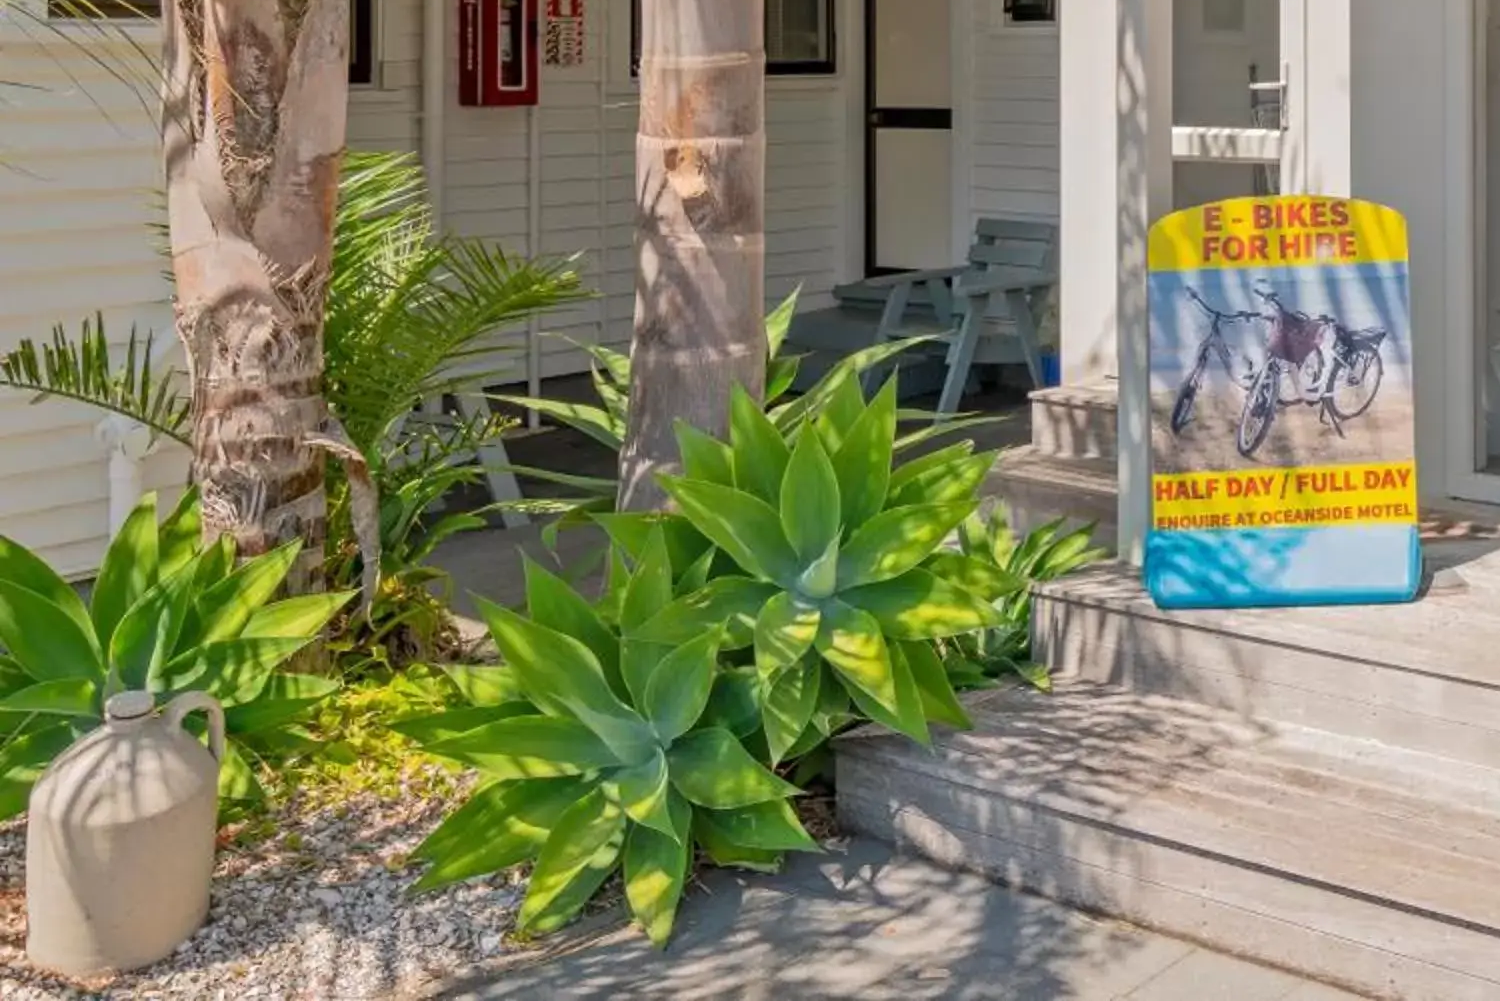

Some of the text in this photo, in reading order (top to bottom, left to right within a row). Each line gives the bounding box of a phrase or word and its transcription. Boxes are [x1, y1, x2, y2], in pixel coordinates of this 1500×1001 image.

[1252, 202, 1350, 229] BIKES
[1203, 231, 1358, 262] FOR HIRE
[1155, 478, 1219, 502] HALF
[1226, 476, 1274, 499] DAY
[1296, 472, 1357, 495] FULL
[1364, 469, 1412, 491] DAY
[1236, 512, 1256, 527] AT
[1260, 506, 1353, 525] OCEANSIDE
[1357, 502, 1413, 519] MOTEL
